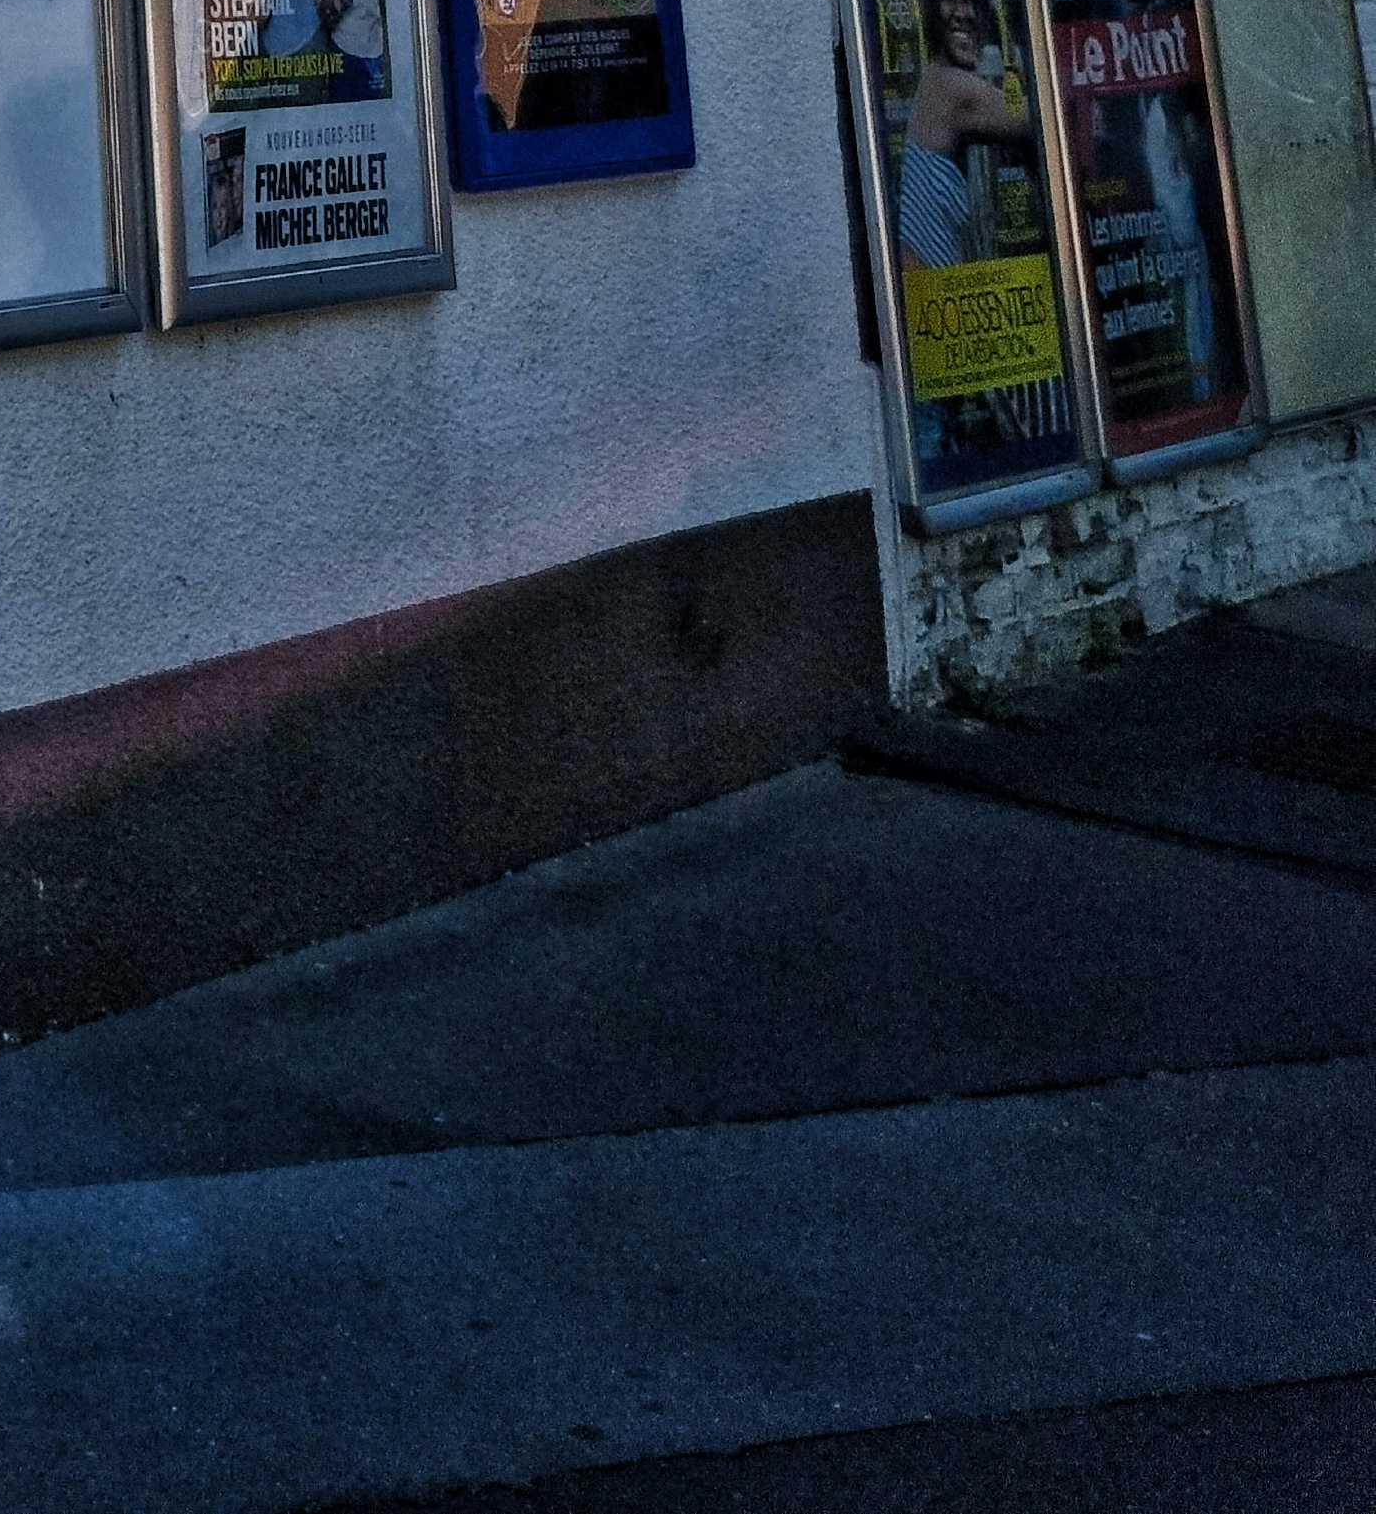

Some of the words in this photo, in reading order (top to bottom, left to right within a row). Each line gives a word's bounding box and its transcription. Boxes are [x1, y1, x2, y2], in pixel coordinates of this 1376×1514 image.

[210, 21, 259, 57] BERN
[1071, 26, 1105, 86] Le
[1106, 12, 1190, 82] Point
[267, 130, 313, 150] NOUVEAU
[255, 159, 323, 203] FRANCE
[325, 155, 367, 195] GALL
[368, 152, 387, 190] ET
[255, 205, 322, 250] MICHEL
[324, 198, 389, 241] BERGER
[1087, 210, 1110, 248] Les
[917, 296, 961, 341] 400
